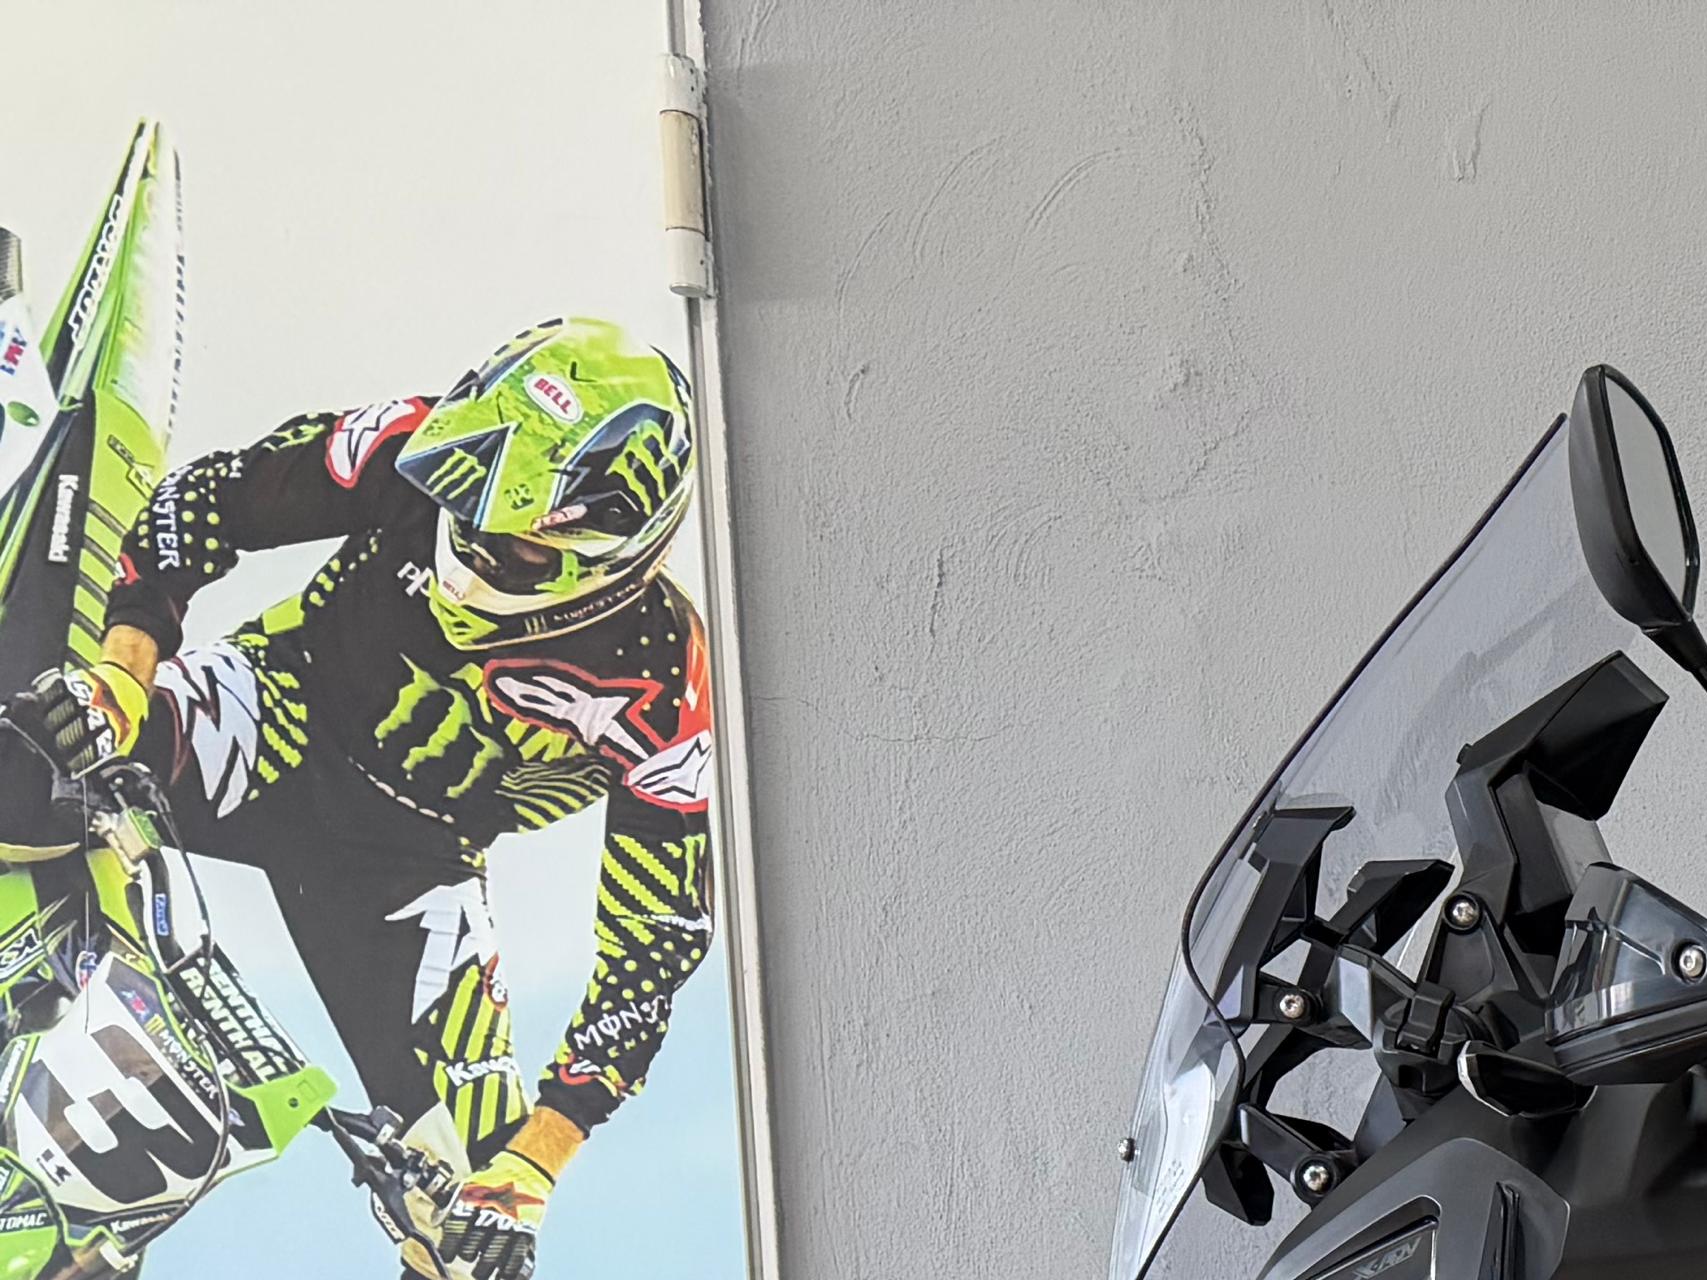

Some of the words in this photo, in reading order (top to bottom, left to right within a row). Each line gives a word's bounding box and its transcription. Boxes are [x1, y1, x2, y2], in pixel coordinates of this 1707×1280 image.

[533, 377, 573, 416] BELL
[151, 464, 193, 571] ONSTER
[158, 1029, 219, 1101] MONSTER
[179, 966, 278, 1084] RENTHAL
